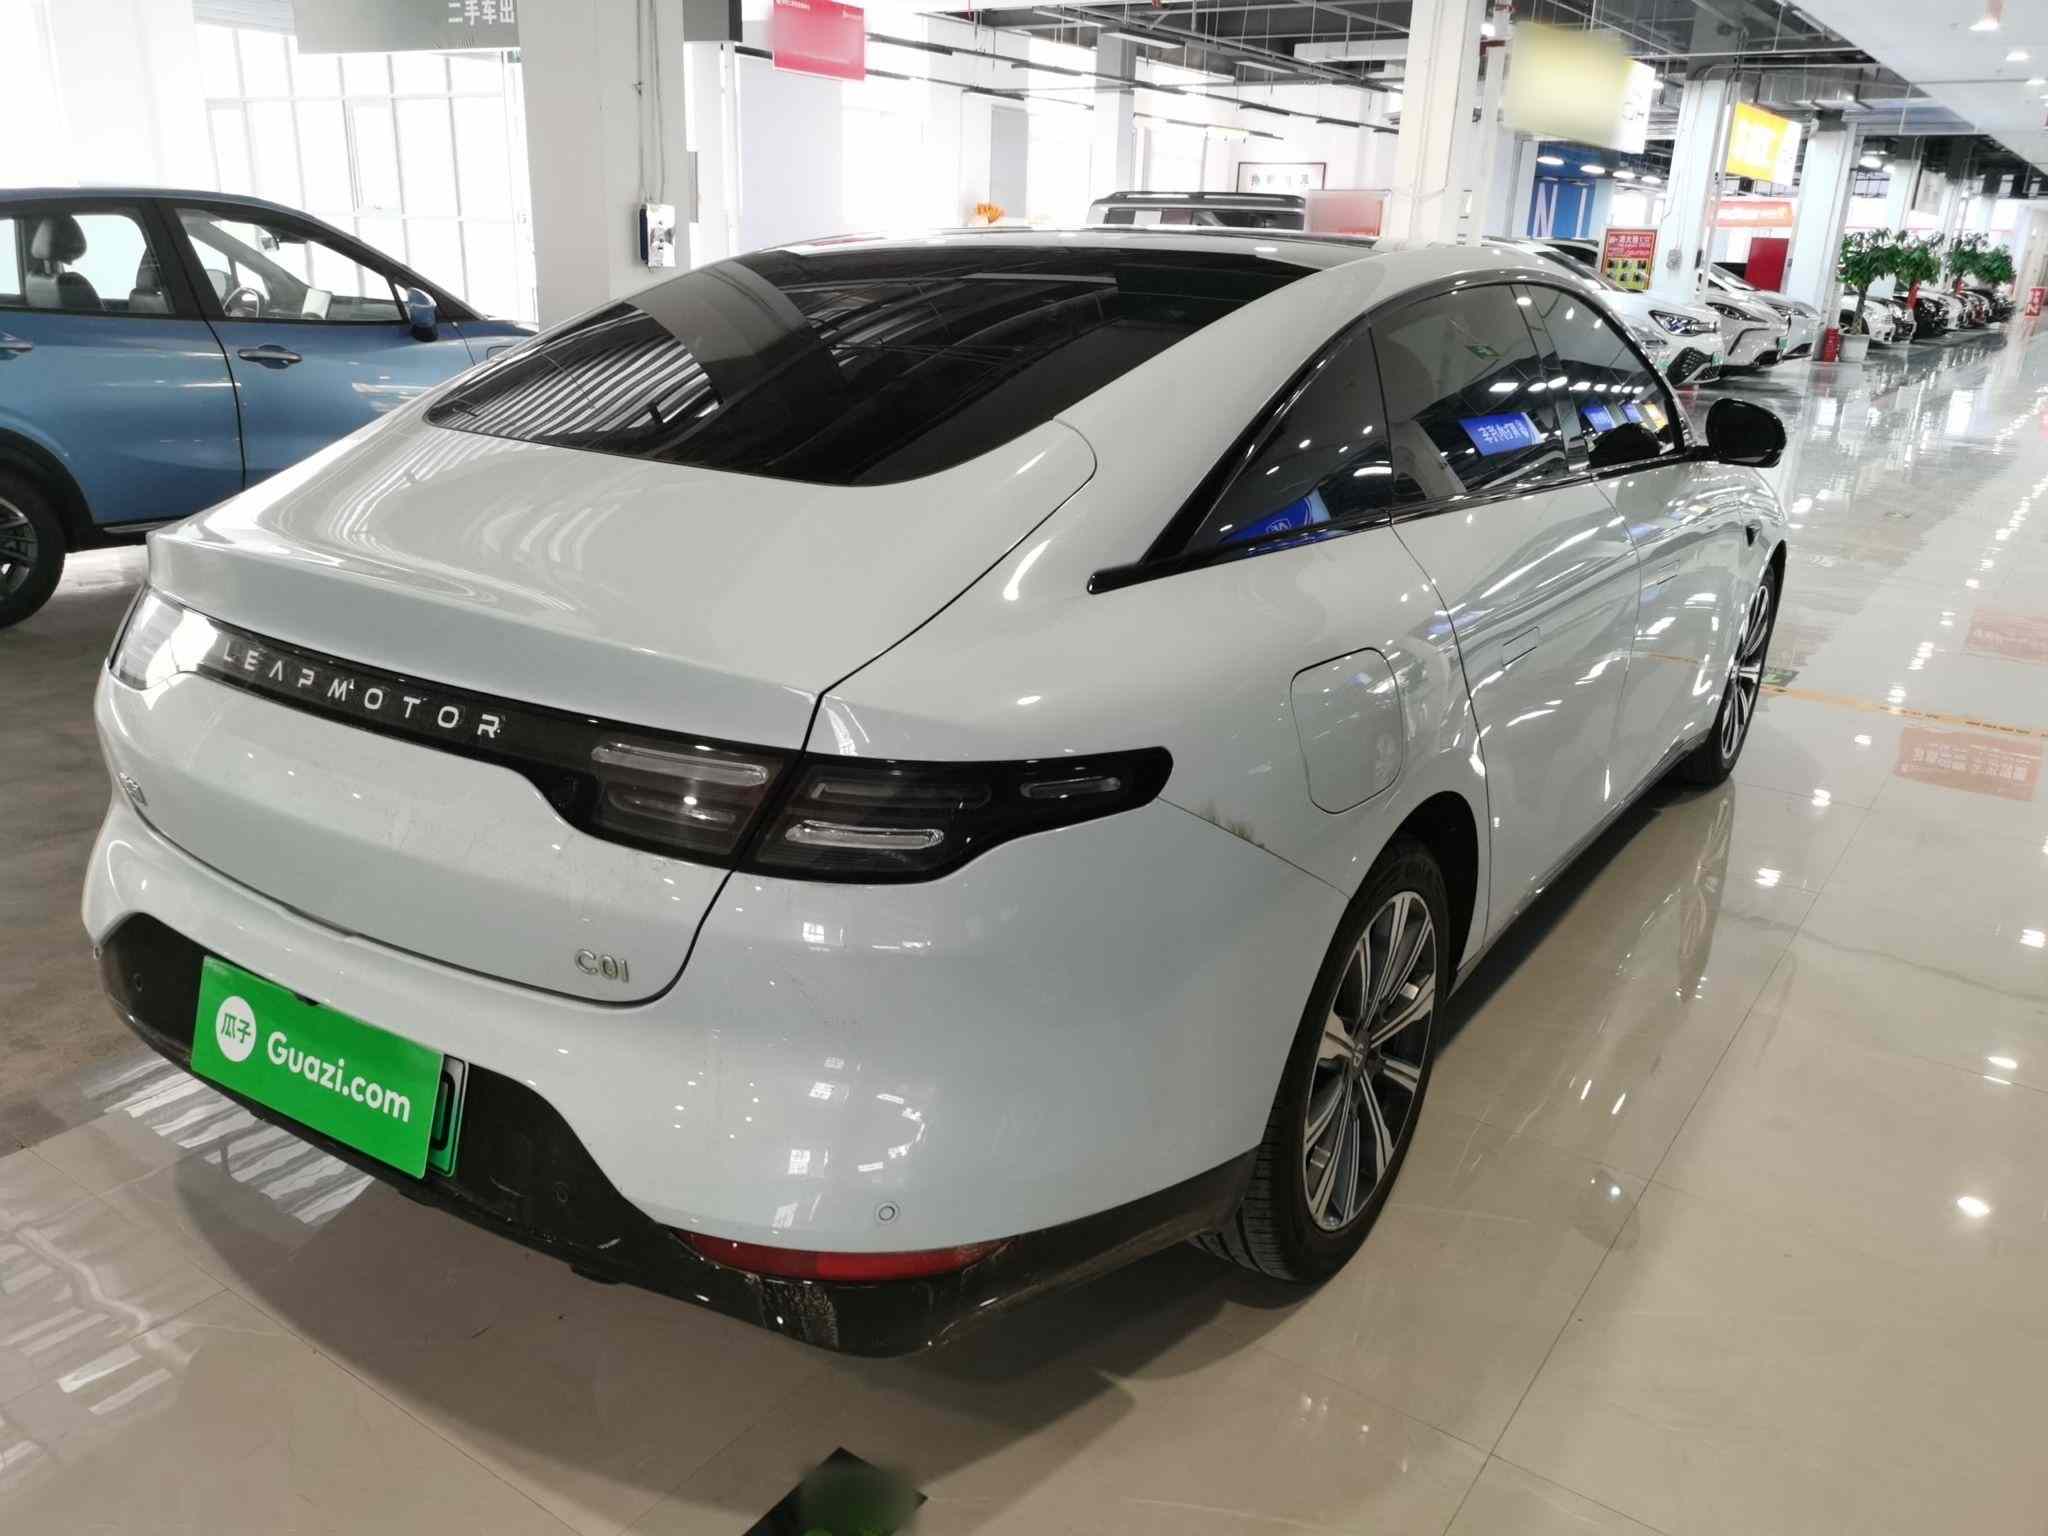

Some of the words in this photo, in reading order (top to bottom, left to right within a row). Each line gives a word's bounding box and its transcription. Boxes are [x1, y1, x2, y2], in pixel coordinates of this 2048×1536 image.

[448, 0, 515, 26] 二手车出
[222, 640, 502, 739] LEAPMOTOR
[220, 1012, 252, 1045] 瓜子
[267, 1031, 412, 1124] Guazi.com
